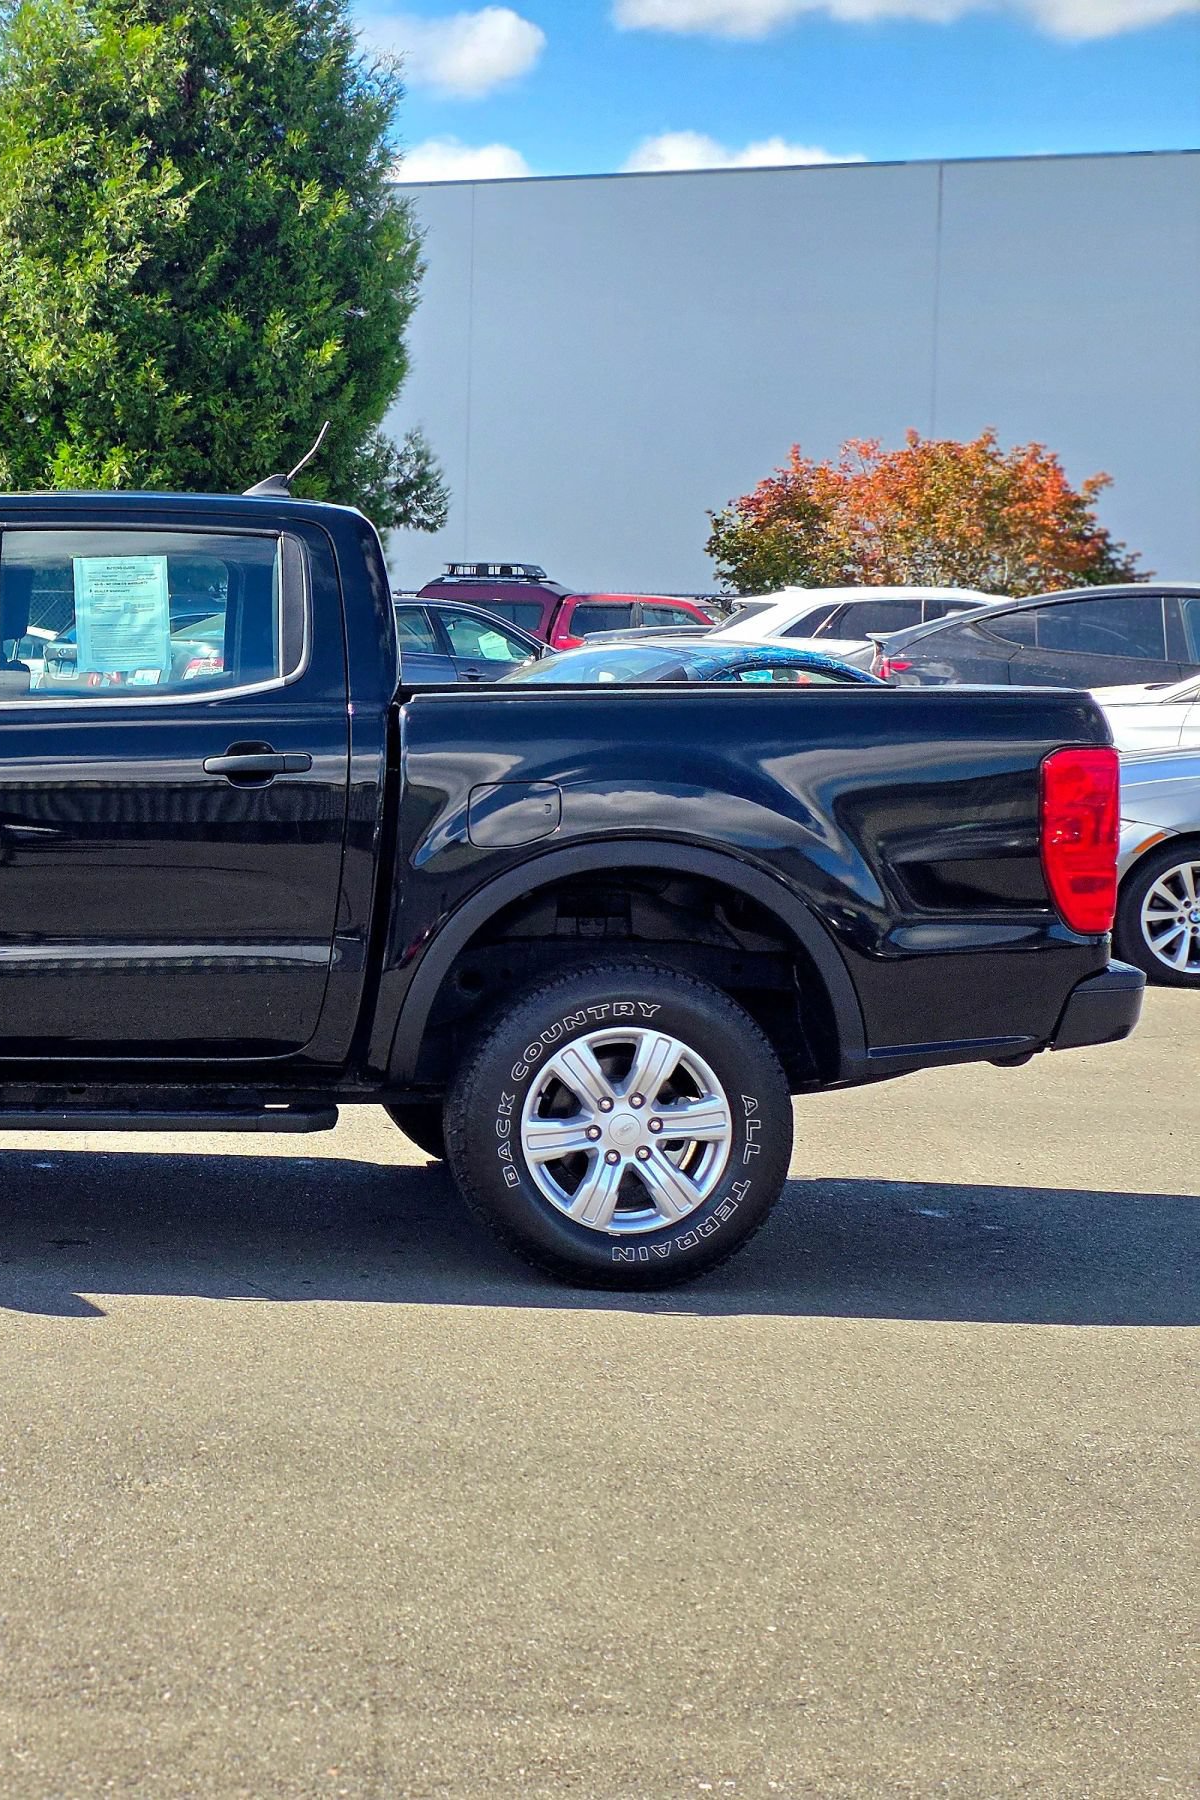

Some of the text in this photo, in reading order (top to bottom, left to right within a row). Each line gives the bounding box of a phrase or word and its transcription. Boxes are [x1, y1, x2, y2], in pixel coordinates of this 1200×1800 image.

[495, 1001, 662, 1188] BACK COUNTRY
[611, 1094, 761, 1262] ALL TERRAIN
